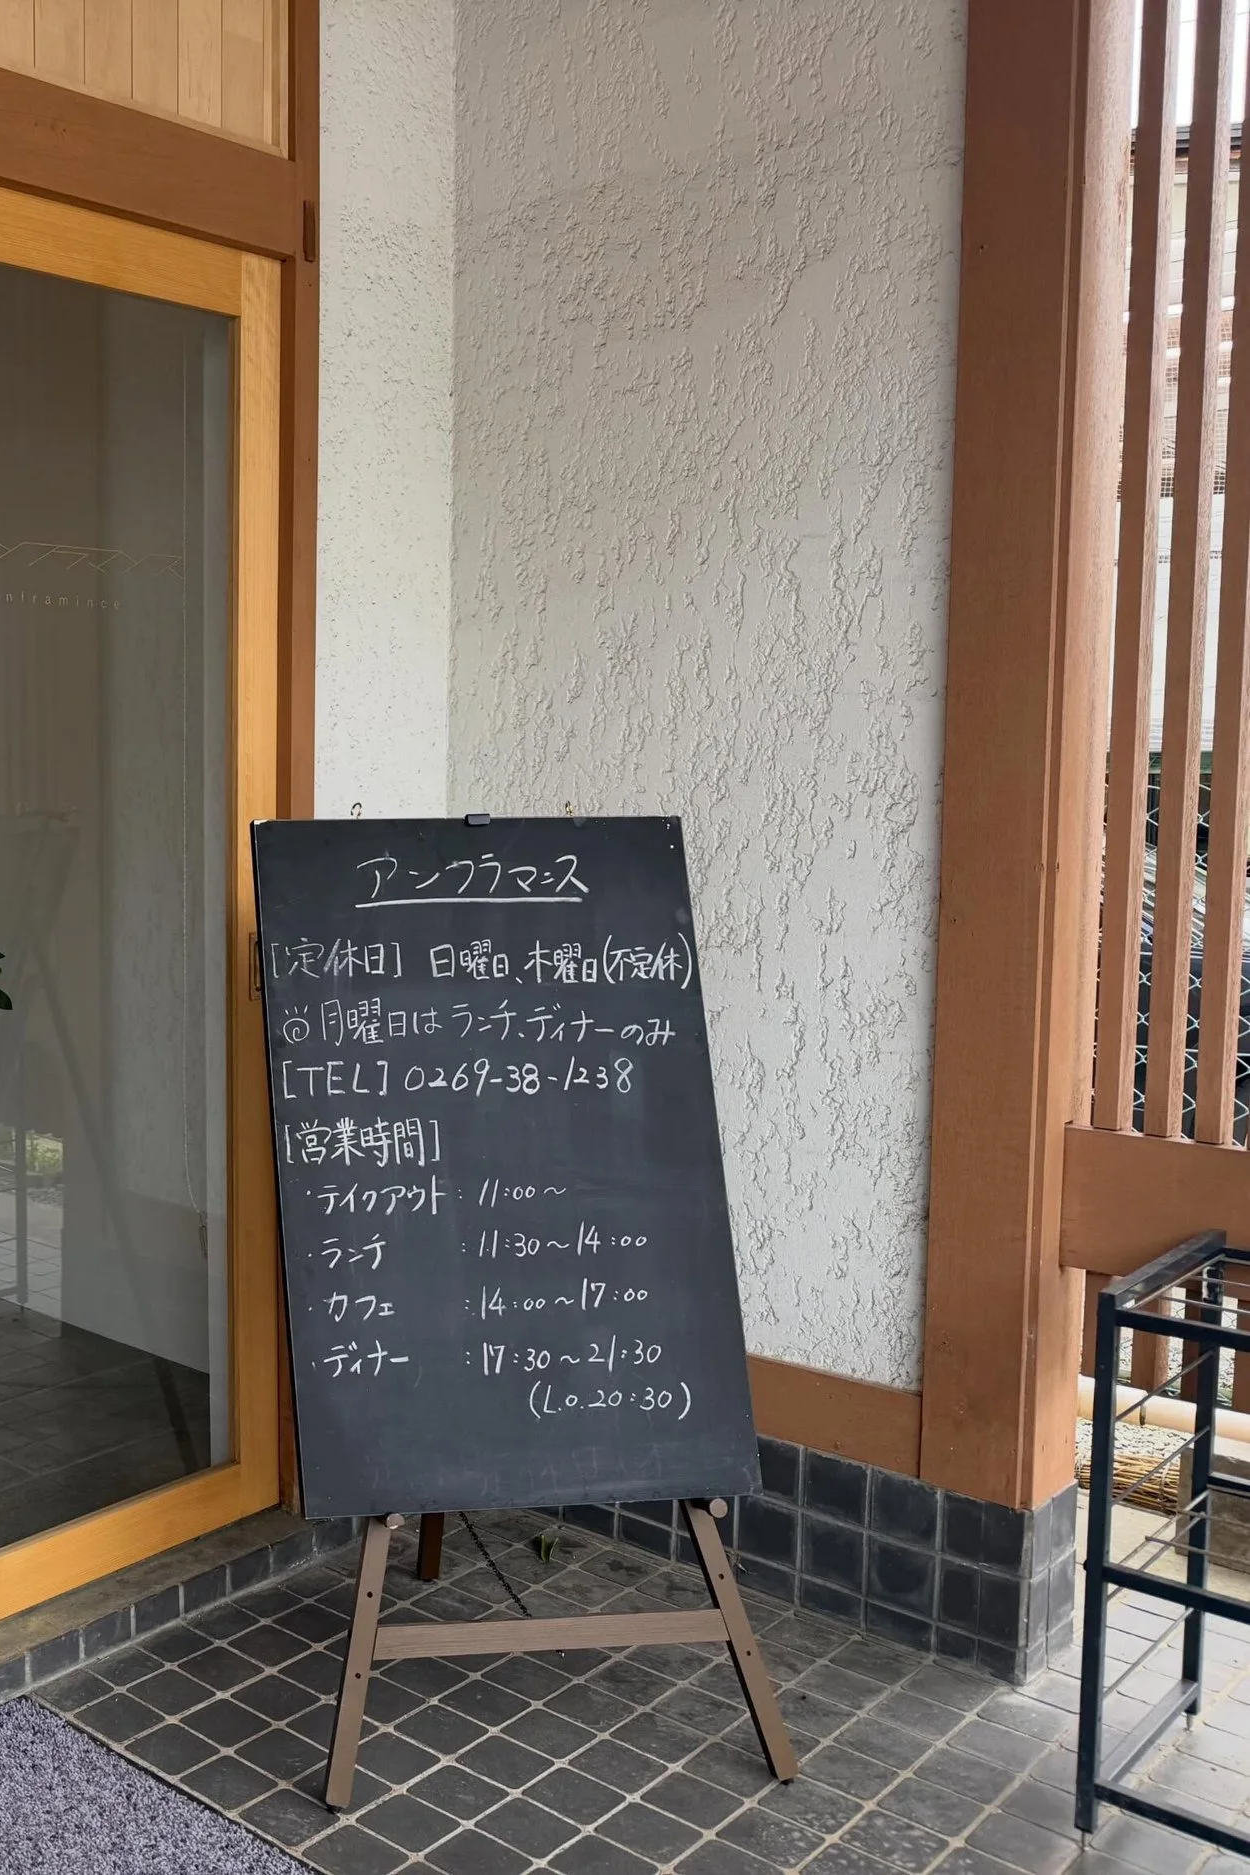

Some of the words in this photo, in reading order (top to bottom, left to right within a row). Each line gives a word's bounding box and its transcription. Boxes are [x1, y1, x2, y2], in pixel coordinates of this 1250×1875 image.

[356, 853, 590, 897] アンフラマンス
[404, 1055, 634, 1097] 0269-38-1238
